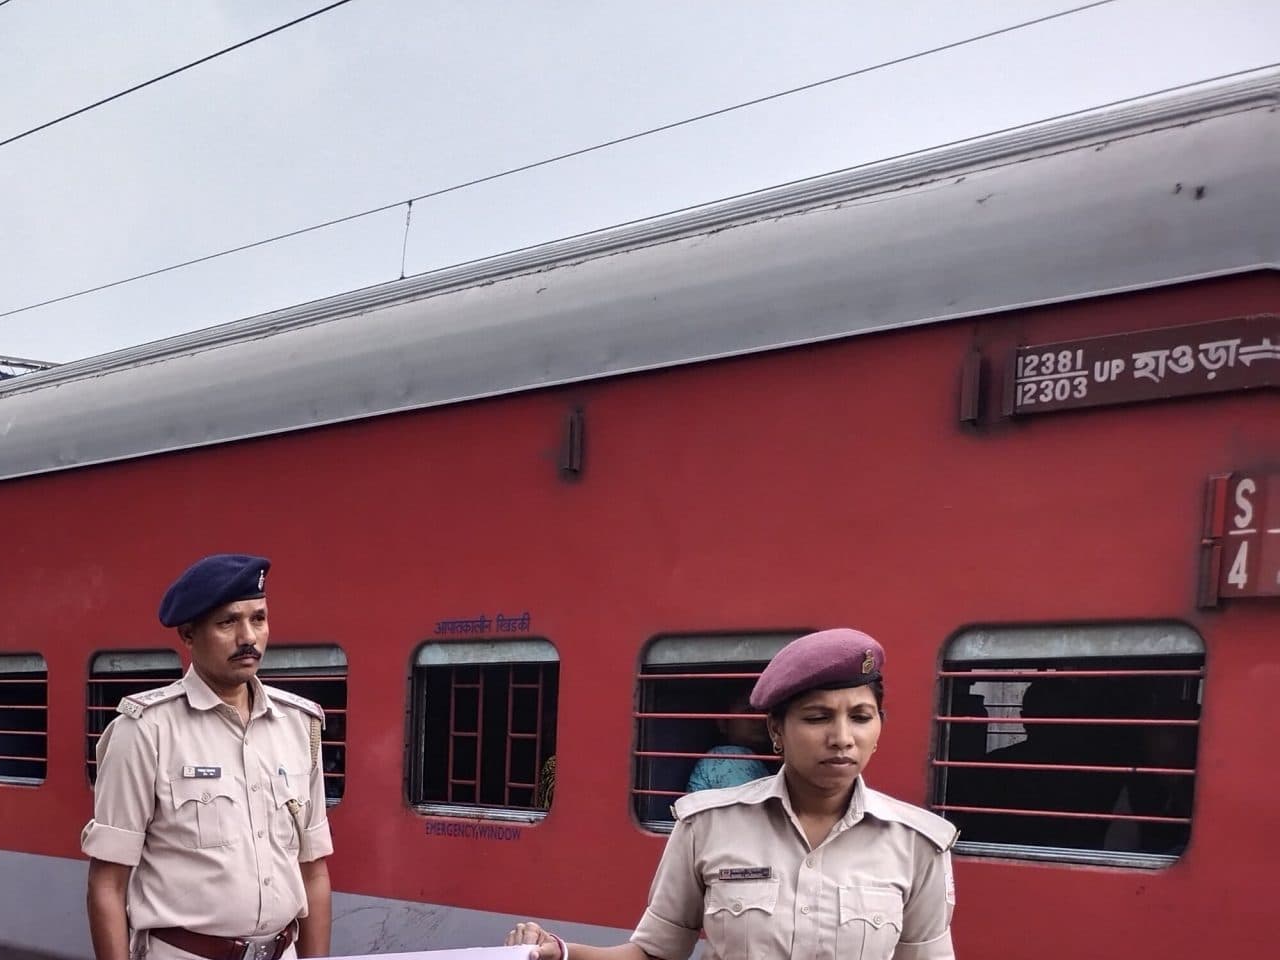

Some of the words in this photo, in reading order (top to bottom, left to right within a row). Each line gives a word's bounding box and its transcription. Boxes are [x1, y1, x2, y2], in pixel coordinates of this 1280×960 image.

[1017, 349, 1084, 377] 12381
[1094, 359, 1125, 382] UP
[1016, 377, 1088, 405] 12303
[1234, 478, 1256, 528] S
[1227, 540, 1249, 589] 4
[425, 822, 477, 839] EMERGENCY
[478, 825, 521, 841] WINDOW
